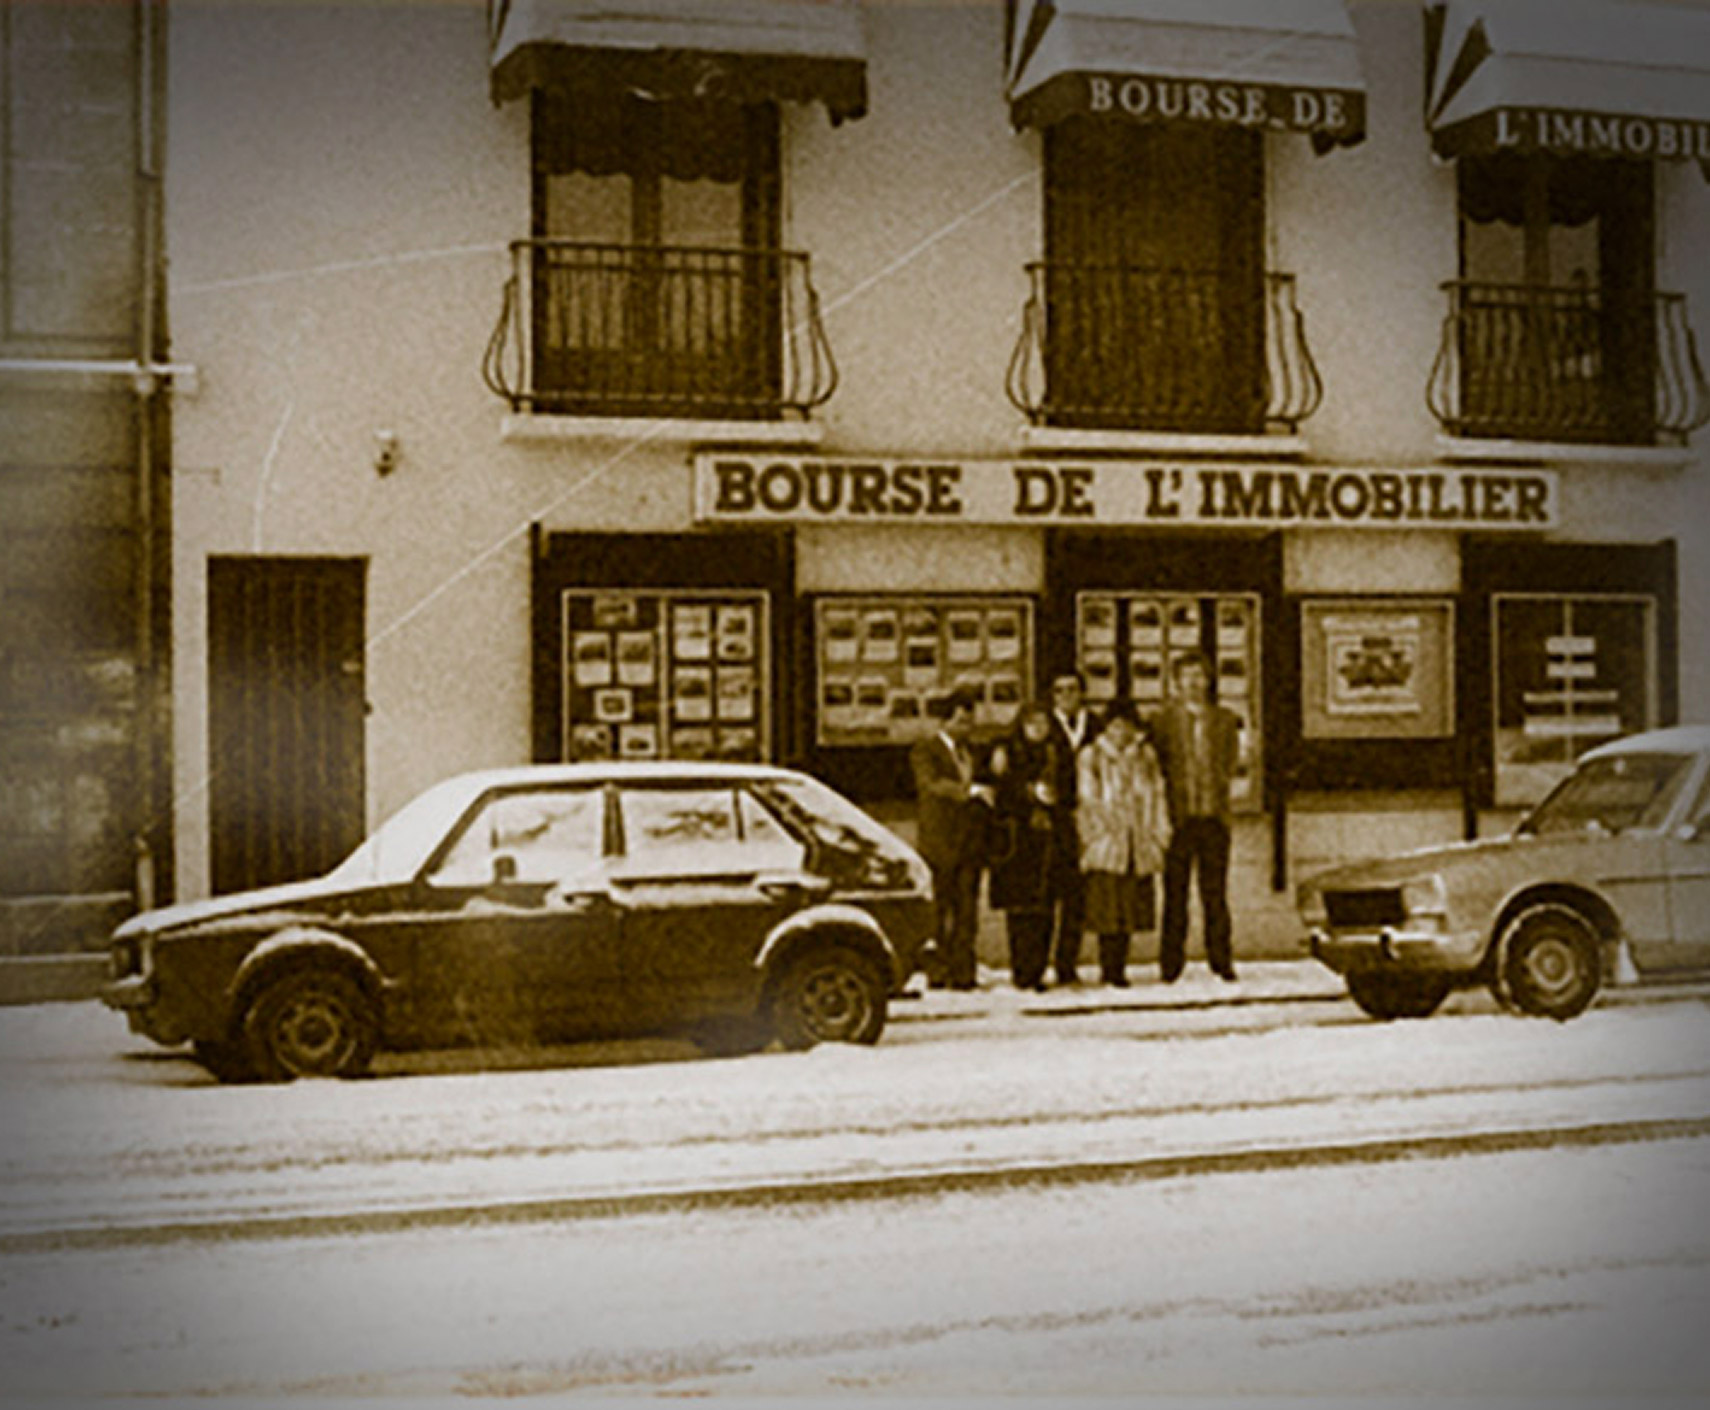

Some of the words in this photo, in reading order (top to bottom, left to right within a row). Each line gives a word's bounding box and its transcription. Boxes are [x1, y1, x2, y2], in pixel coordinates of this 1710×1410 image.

[1090, 77, 1267, 126] BOURSE
[1292, 91, 1347, 128] DE
[714, 461, 962, 515] BOURSE
[1013, 467, 1095, 516] DE
